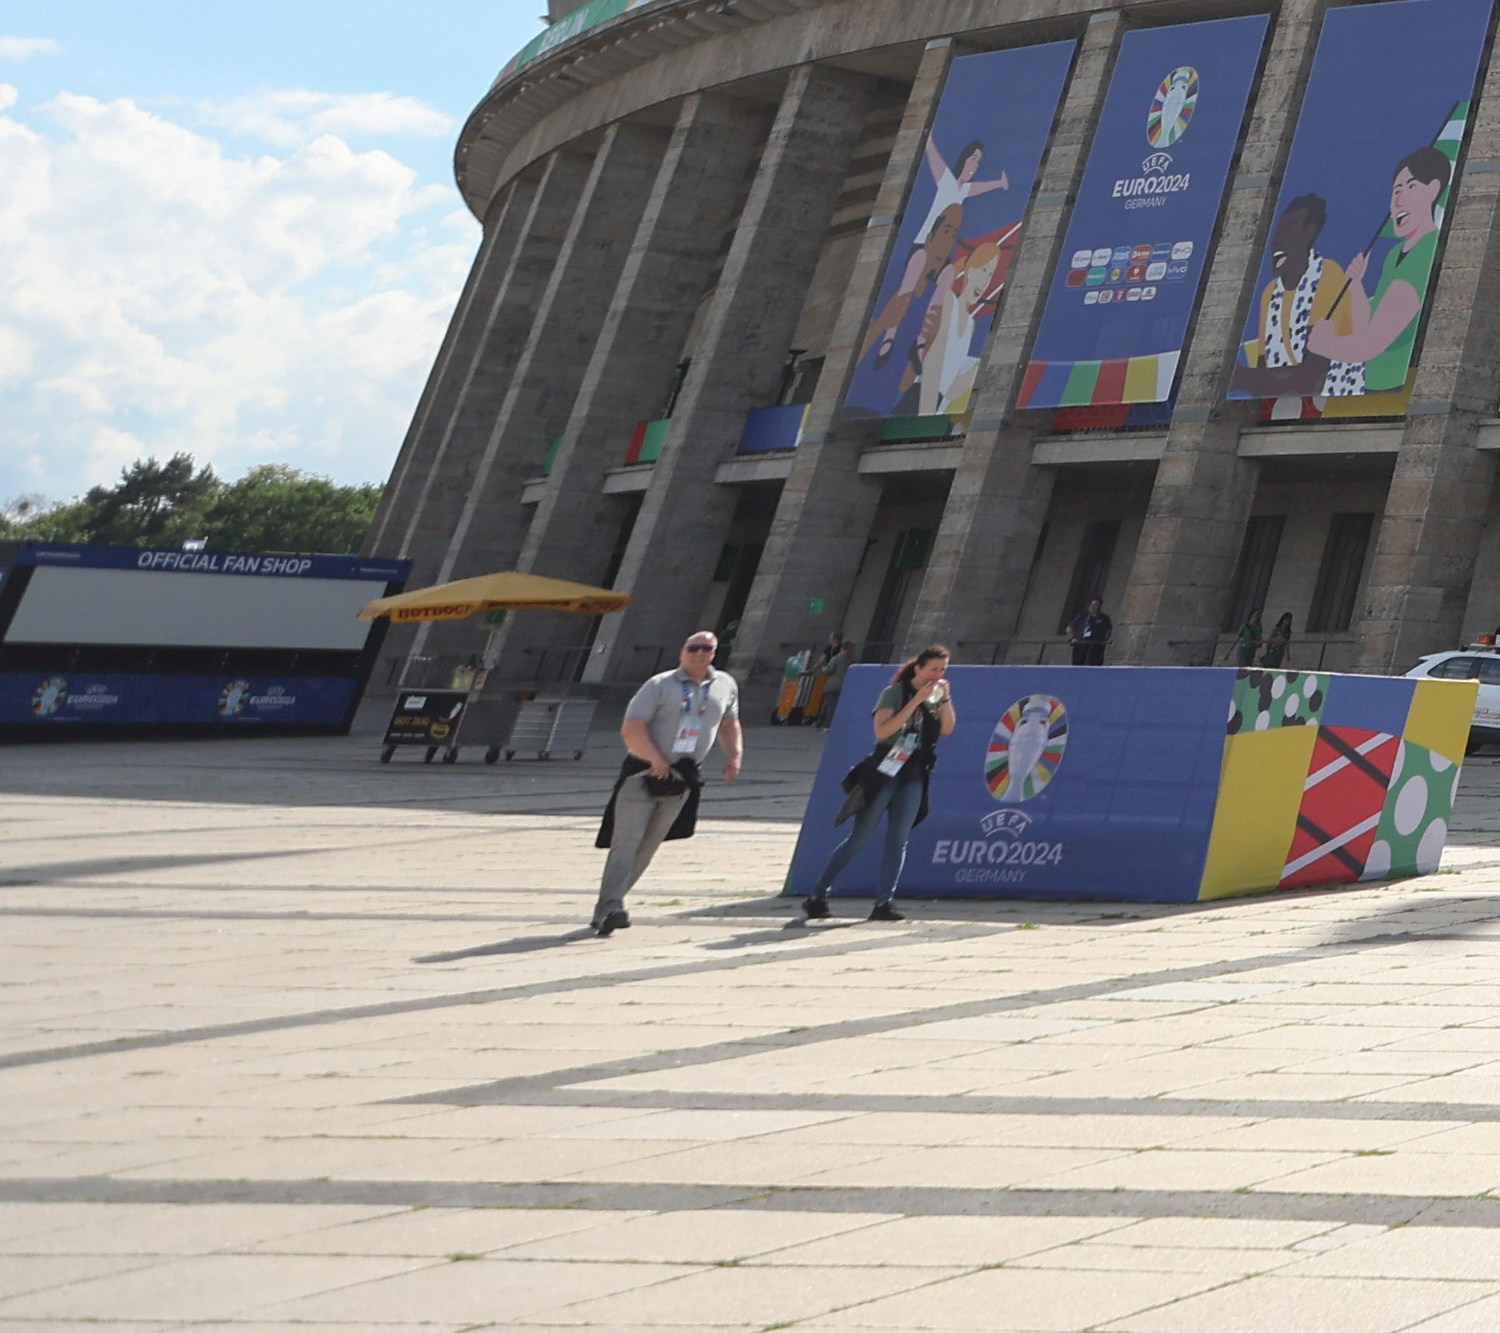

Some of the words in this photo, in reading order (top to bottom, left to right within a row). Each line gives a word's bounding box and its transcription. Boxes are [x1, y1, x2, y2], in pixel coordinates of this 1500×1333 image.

[1141, 155, 1170, 172] UEFA
[1111, 173, 1190, 198] EURO2024
[1124, 196, 1168, 210] GERMANY
[137, 550, 219, 571] OFFICIAL
[222, 554, 261, 572] FAN
[262, 556, 312, 575] SHOP
[981, 813, 1028, 834] UEFA
[931, 840, 1063, 865] EURO2024
[954, 868, 1028, 883] GERMANY
